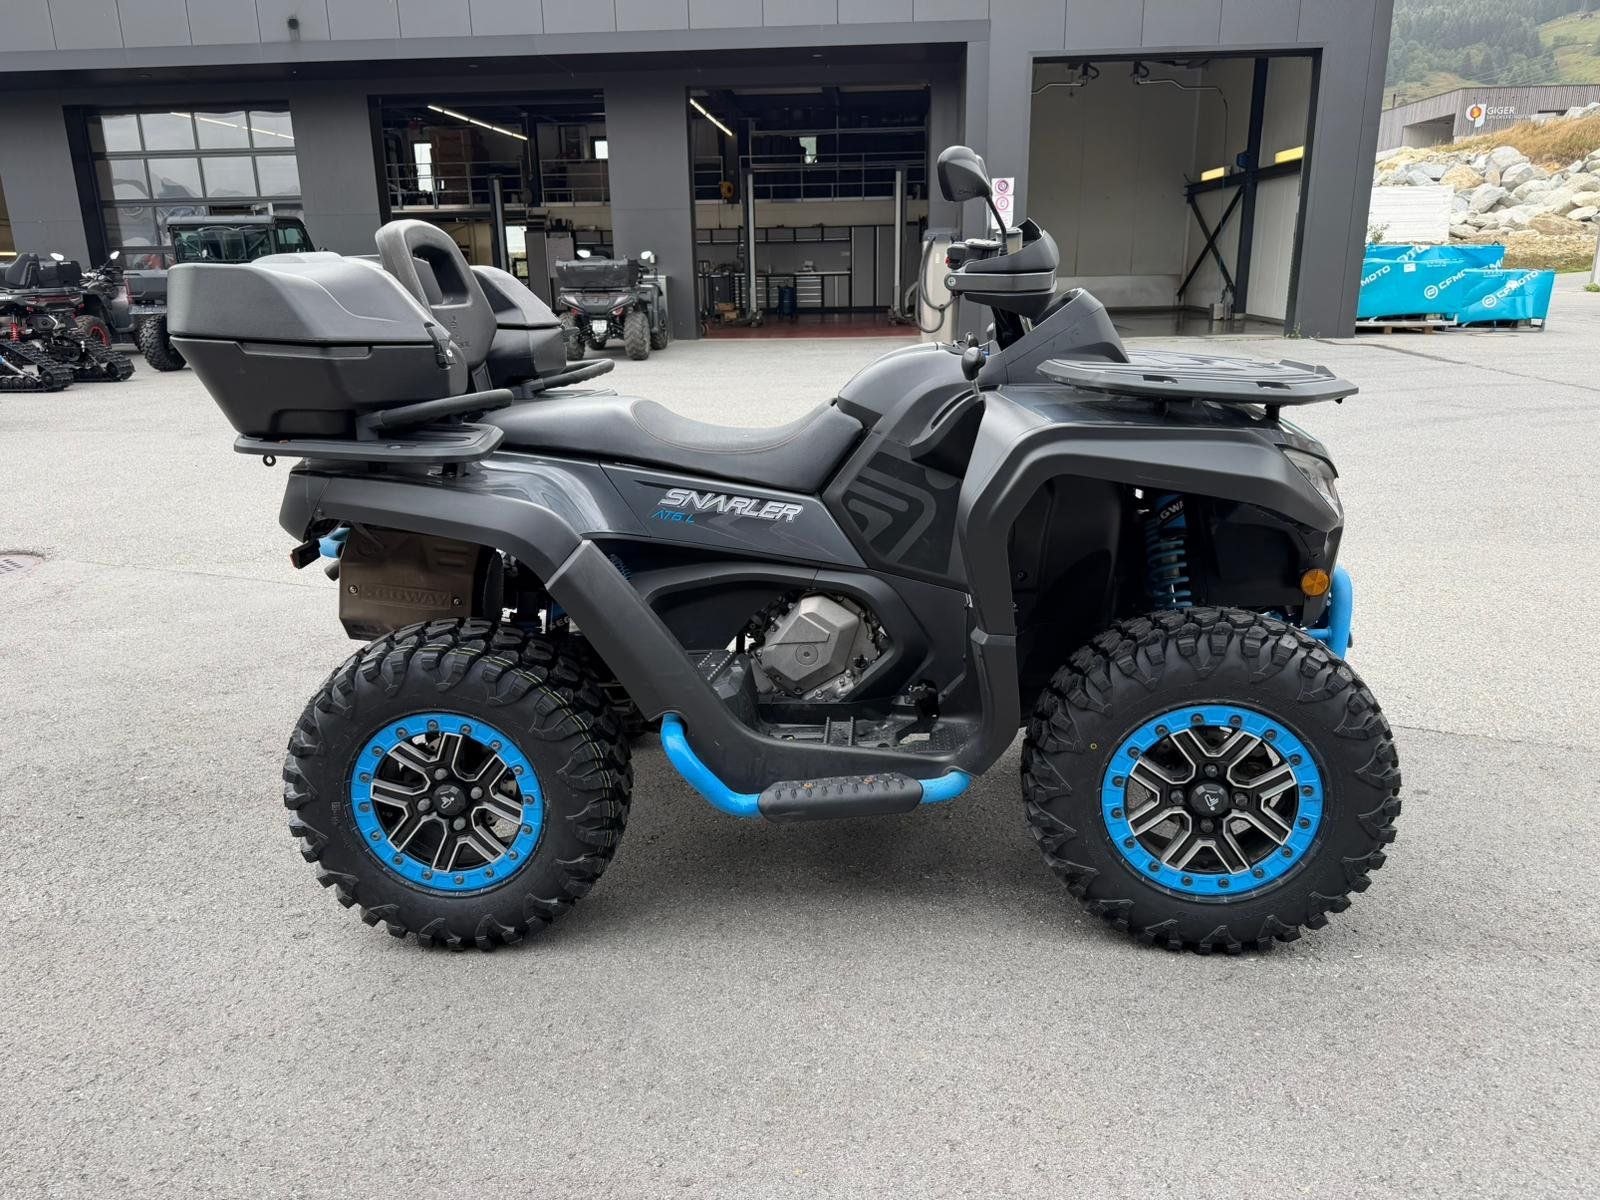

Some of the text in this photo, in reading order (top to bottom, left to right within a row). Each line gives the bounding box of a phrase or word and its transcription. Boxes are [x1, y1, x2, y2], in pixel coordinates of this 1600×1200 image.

[1487, 106, 1515, 115] GIGER
[657, 488, 803, 522] SNARLER
[361, 585, 448, 606] EGWAY
